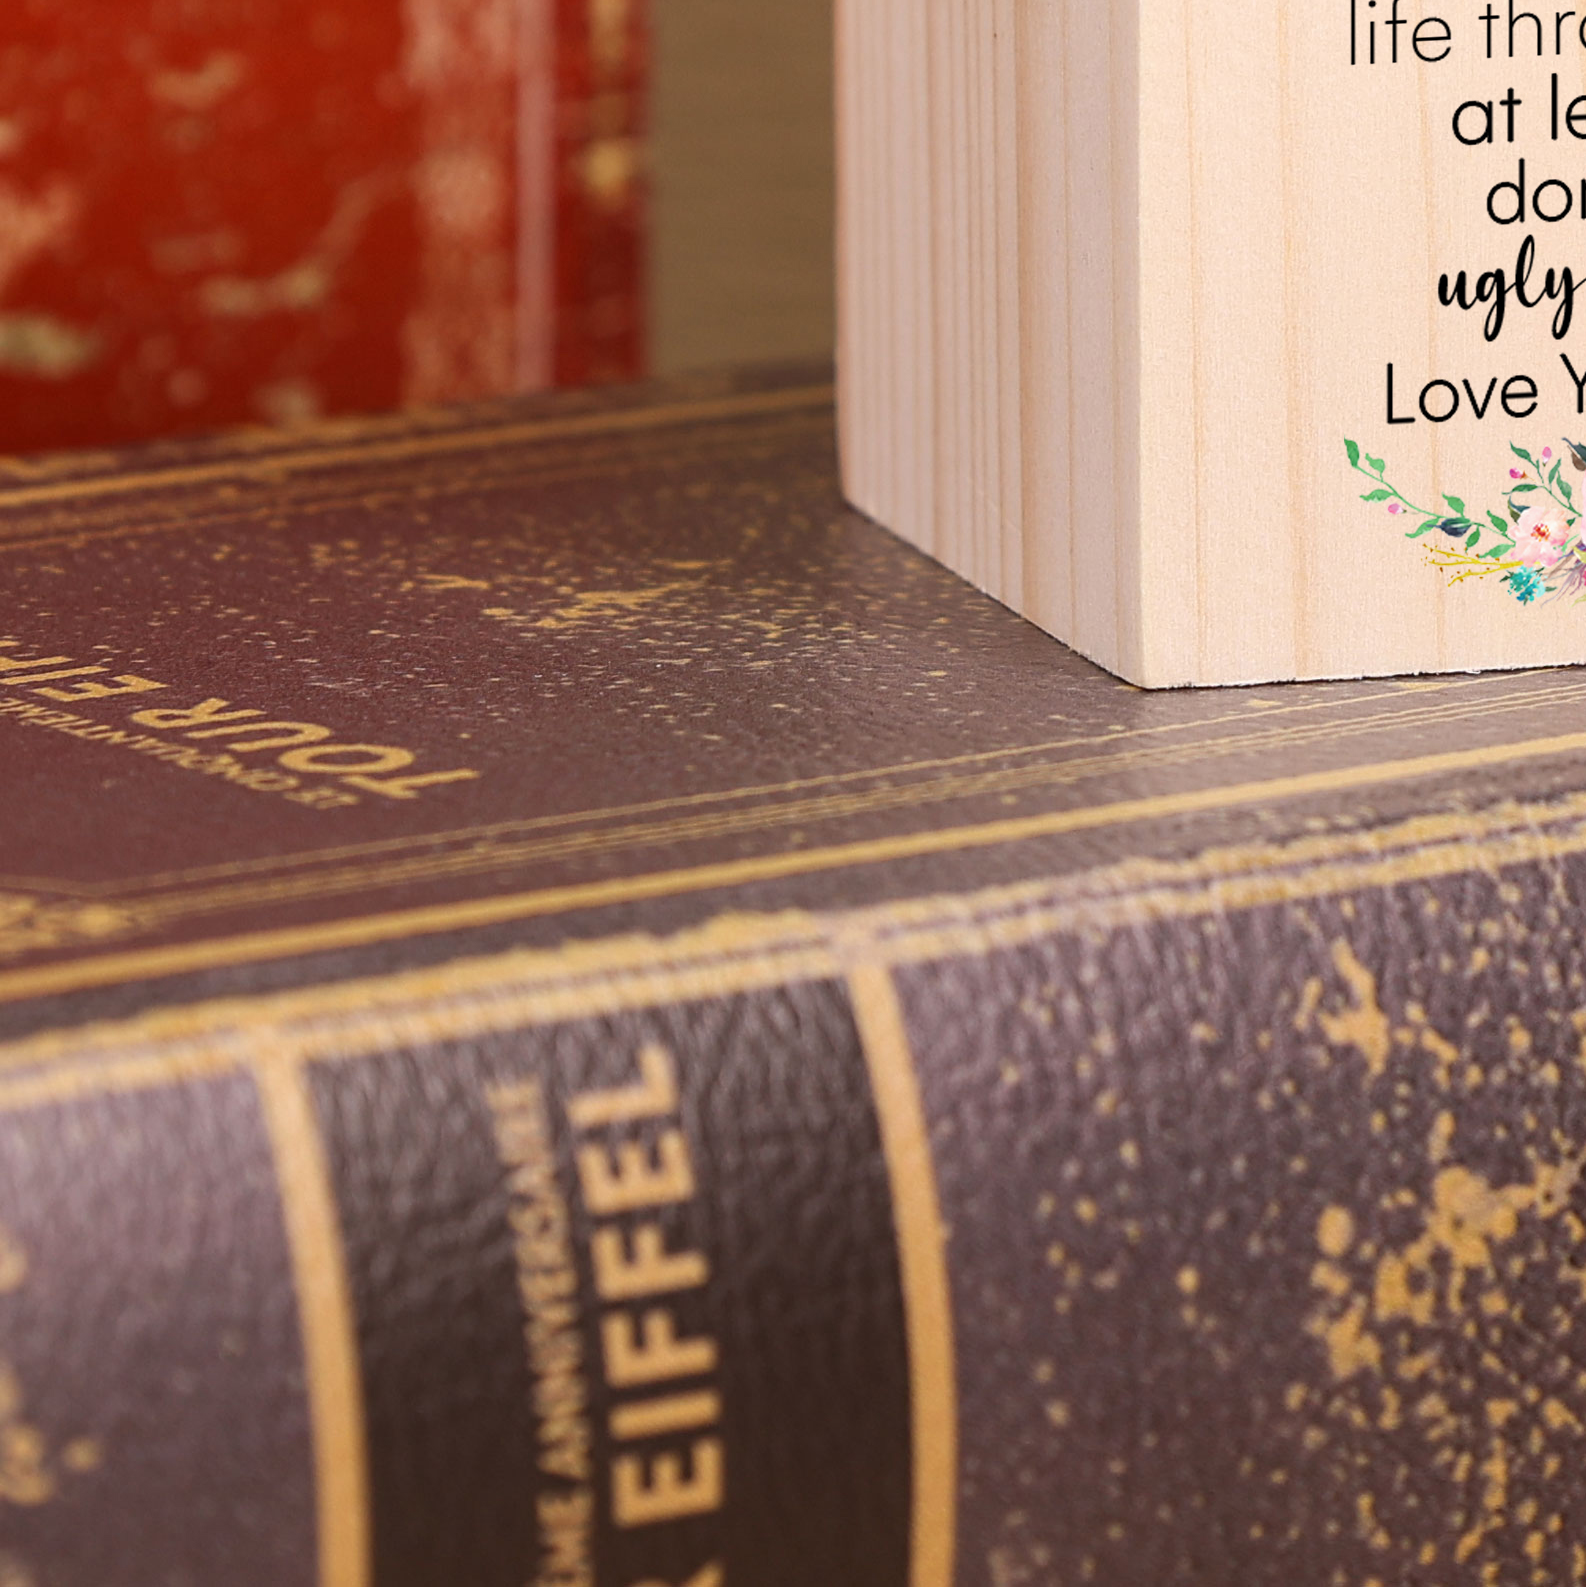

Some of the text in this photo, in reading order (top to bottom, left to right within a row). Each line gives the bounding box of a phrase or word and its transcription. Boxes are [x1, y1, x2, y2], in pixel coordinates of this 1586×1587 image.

[1451, 86, 1523, 146] at
[1385, 361, 1539, 425] Love
[130, 697, 481, 799] TOUR
[566, 1043, 724, 1530] EIFFEL
